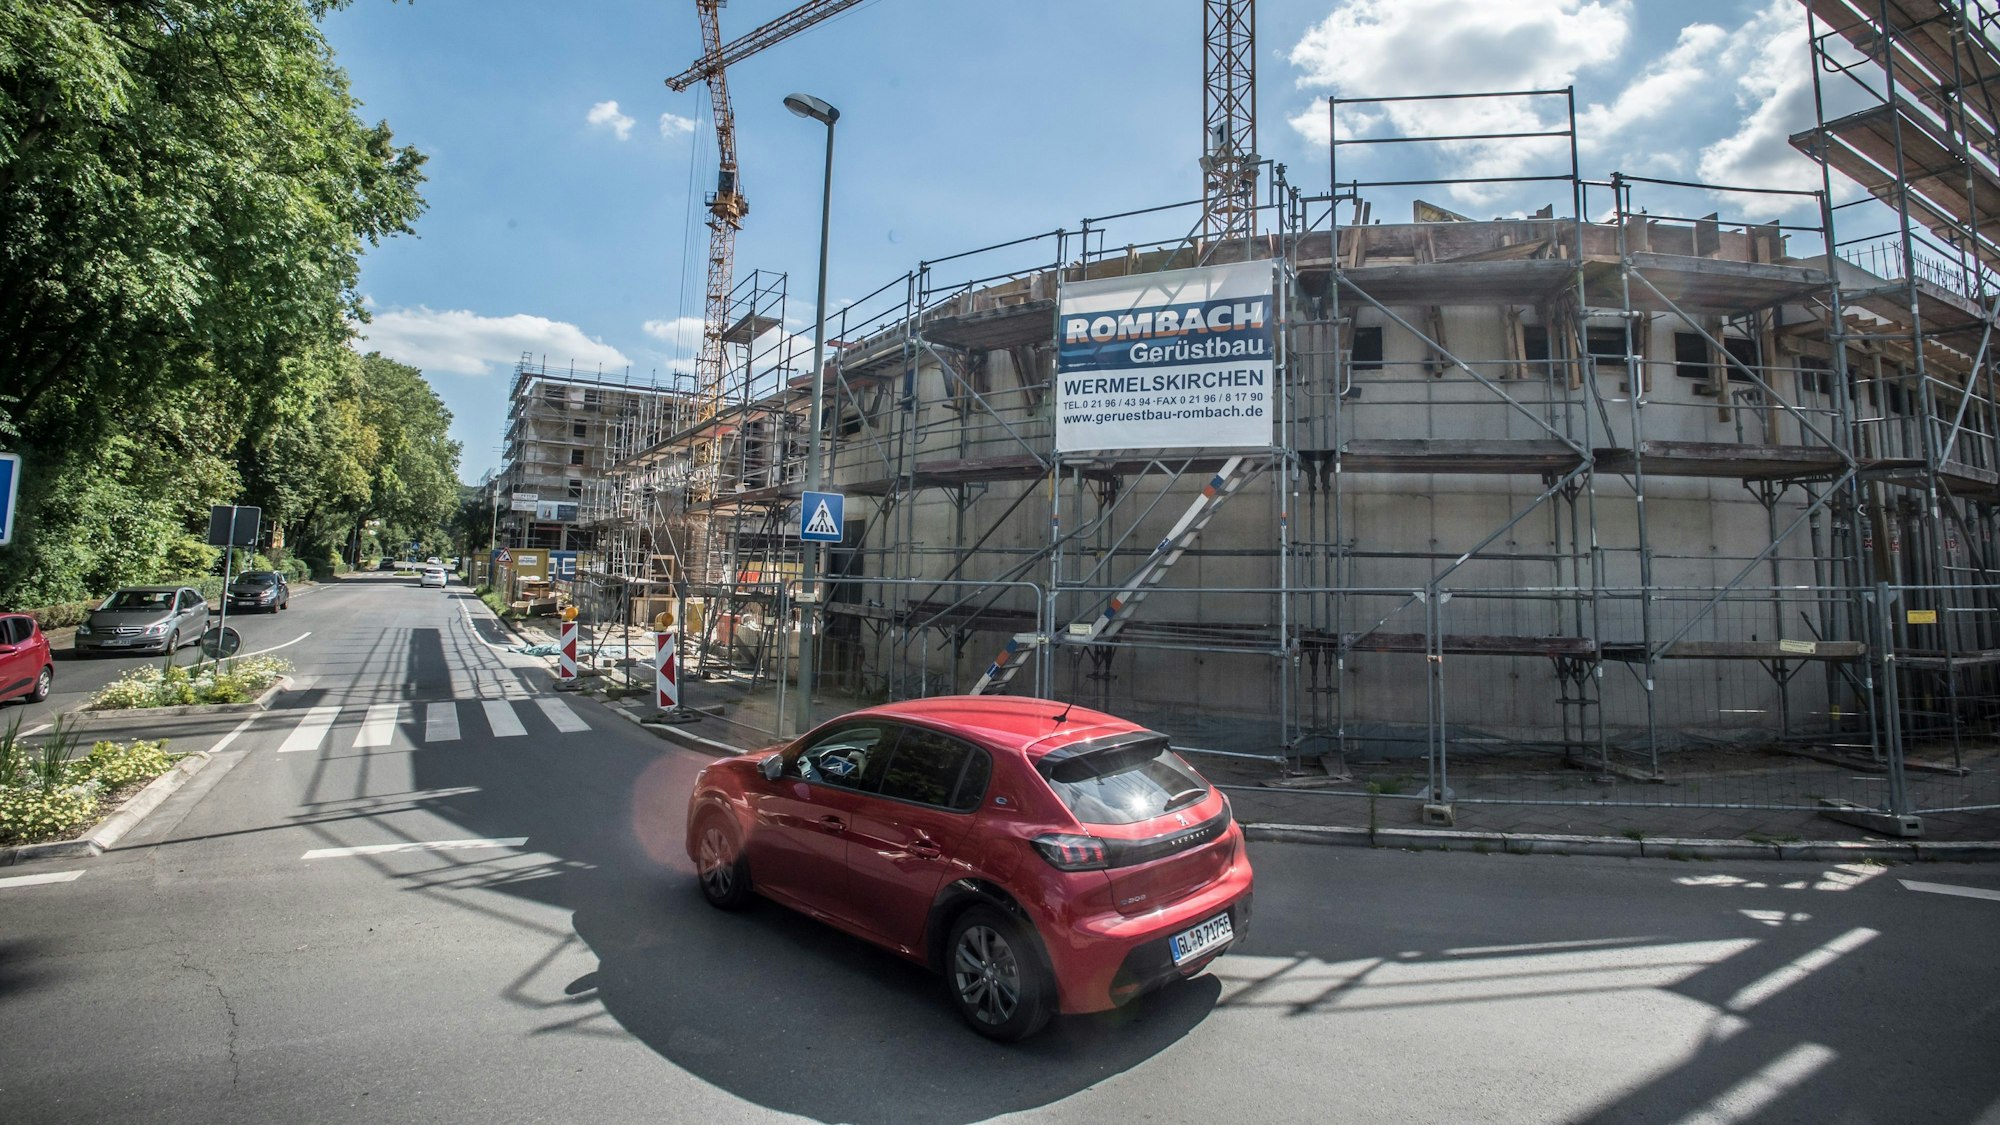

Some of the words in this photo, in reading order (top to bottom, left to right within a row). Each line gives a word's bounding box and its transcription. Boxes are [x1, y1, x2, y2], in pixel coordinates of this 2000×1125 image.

[1066, 301, 1263, 344] ROMBACH
[1130, 337, 1263, 363] Gerüstbau
[1064, 369, 1263, 396] WERMELSKIRCHEN
[1091, 400, 1102, 408] 21
[1105, 399, 1116, 407] 96
[1124, 398, 1136, 406] 43
[1139, 397, 1150, 406] 94
[1180, 395, 1186, 404] 0
[1189, 395, 1200, 403] 21
[1204, 394, 1216, 403] 96
[1225, 393, 1231, 401] 8
[1235, 393, 1247, 401] 17
[1250, 392, 1263, 401] 90
[1063, 405, 1263, 425] www.geruestbau-rombach.de
[1177, 936, 1192, 956] GL
[1195, 929, 1203, 947] B
